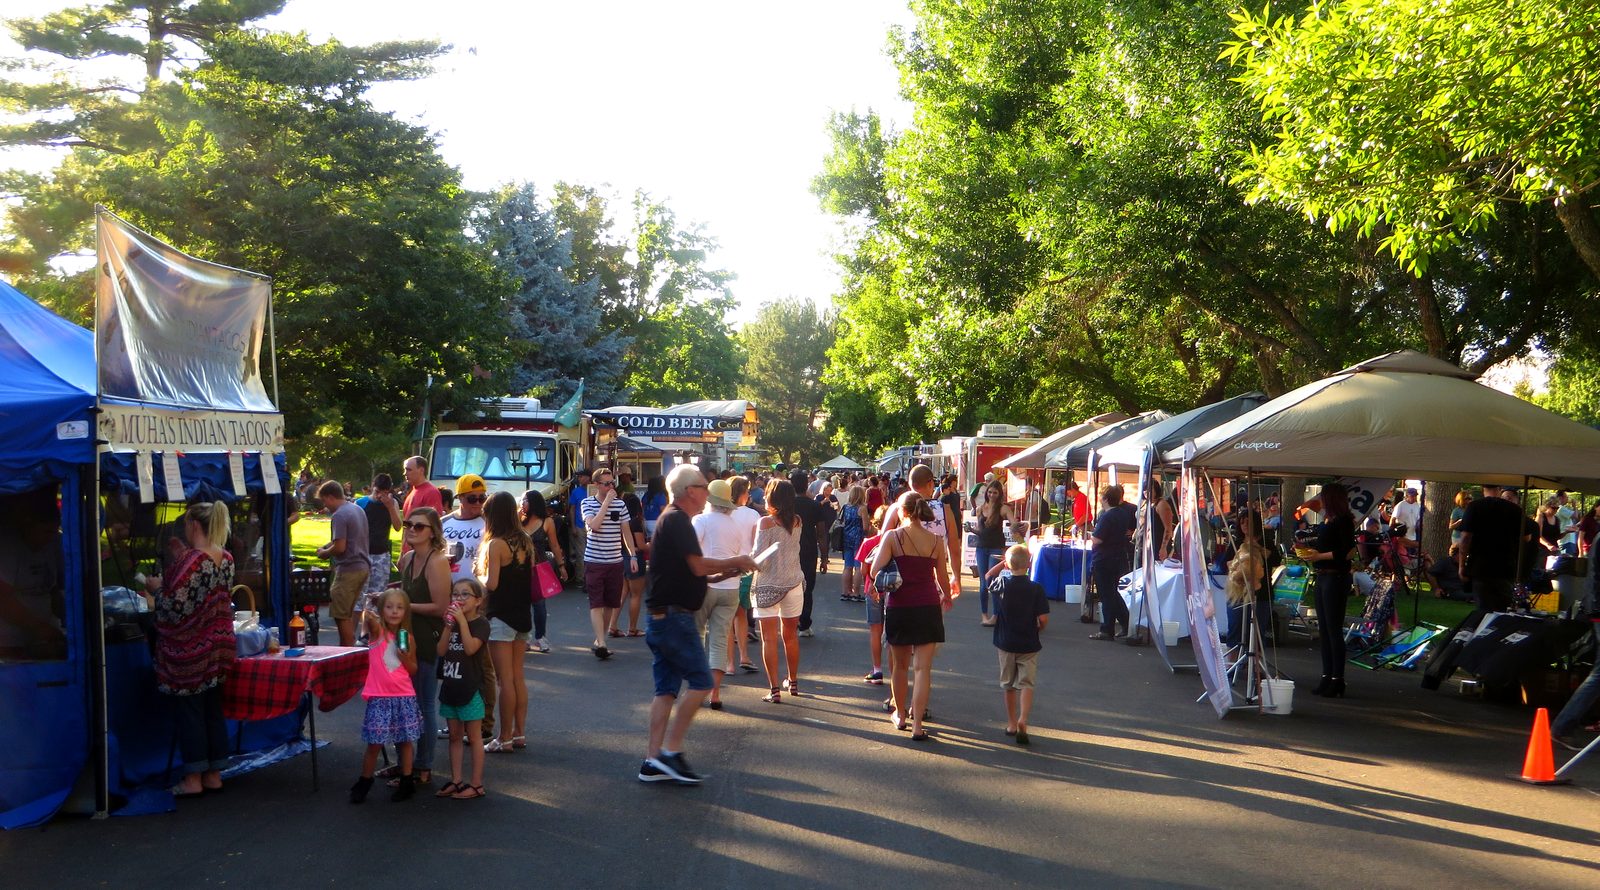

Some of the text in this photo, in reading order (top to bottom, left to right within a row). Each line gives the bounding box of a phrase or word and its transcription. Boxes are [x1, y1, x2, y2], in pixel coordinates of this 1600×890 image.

[617, 415, 666, 428] COLD
[668, 417, 714, 430] BEER
[119, 414, 272, 446] MUHA'S INDIAN TACOS
[1233, 440, 1282, 453] chapter
[443, 526, 481, 540] Coors
